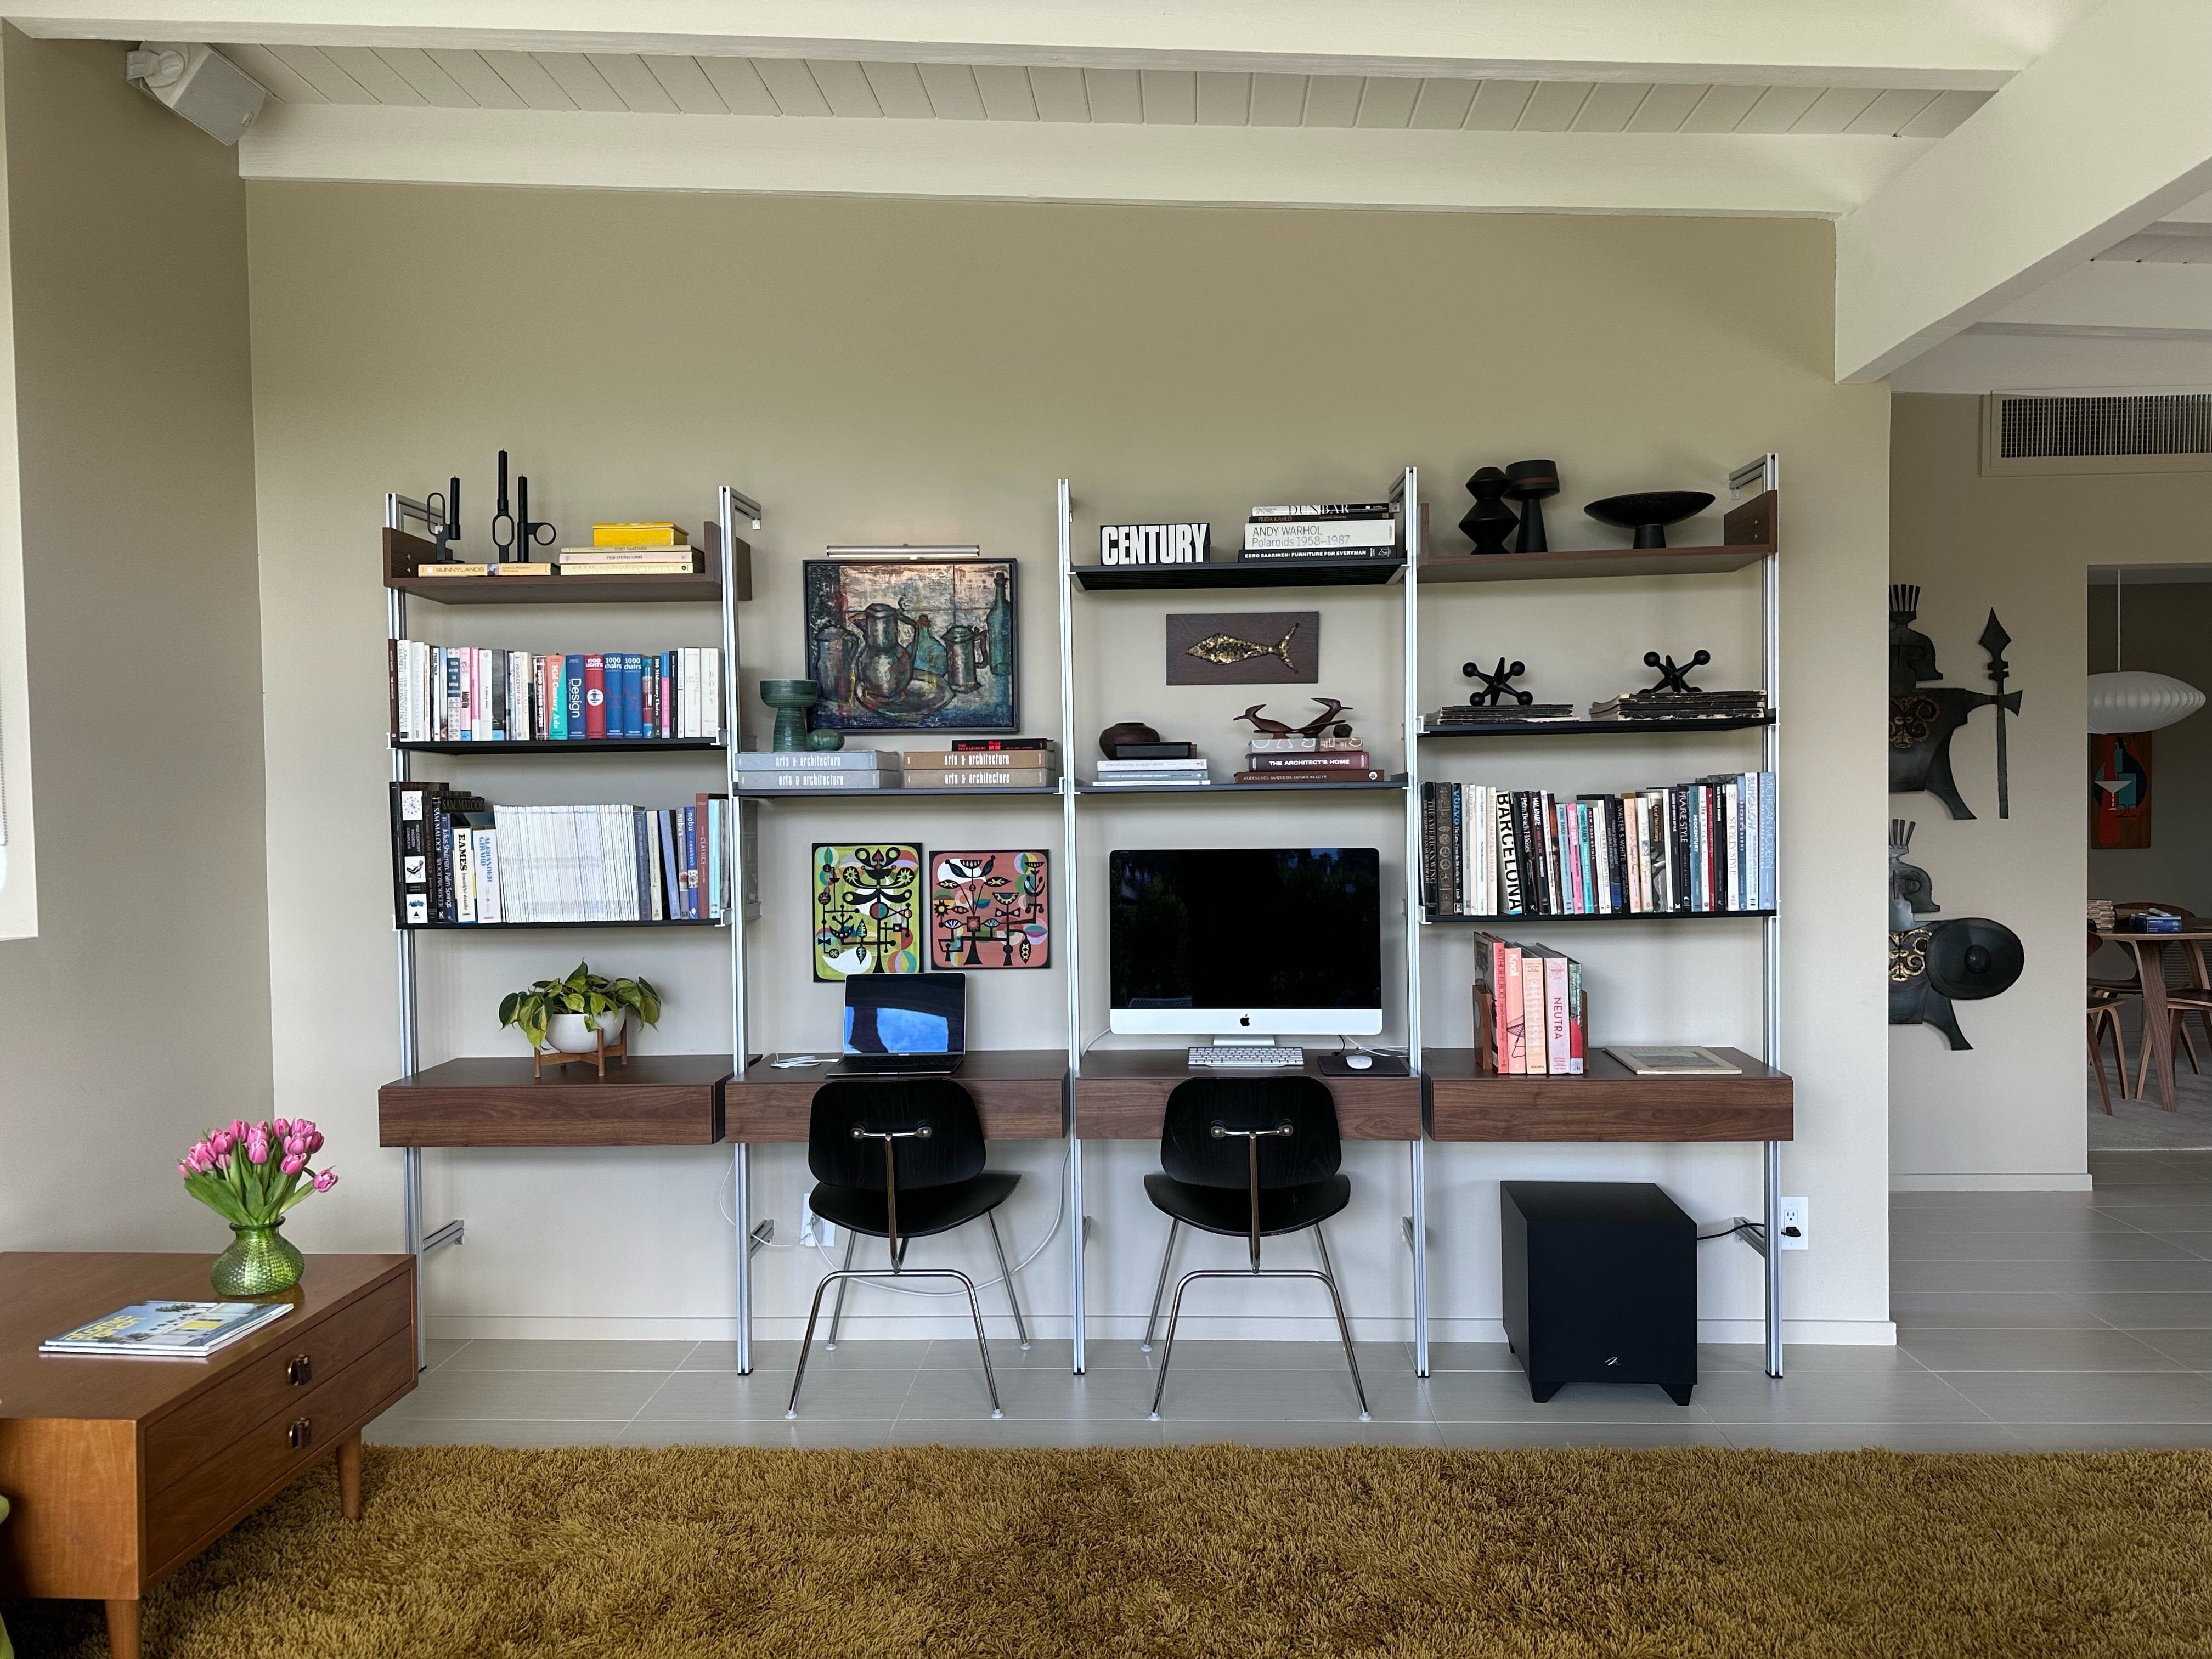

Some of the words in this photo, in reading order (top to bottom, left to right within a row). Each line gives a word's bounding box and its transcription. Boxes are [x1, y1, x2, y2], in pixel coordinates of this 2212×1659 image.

[1290, 505, 1349, 515] DUNBAR
[1253, 527, 1279, 536] ANDY
[1282, 526, 1322, 535] WARHOL
[1102, 524, 1207, 565] CENTURY
[1252, 537, 1294, 547] Polaroids
[569, 678, 582, 718] Design
[776, 756, 789, 766] arts
[800, 755, 840, 766] architecture
[945, 754, 957, 765] arts
[961, 755, 966, 765] &
[969, 753, 1009, 765] architecture
[779, 775, 792, 785] arts
[795, 775, 800, 785] &
[803, 774, 844, 785] architecture
[945, 773, 958, 784] arts
[962, 774, 966, 784] &
[969, 772, 1009, 784] architecture
[443, 800, 455, 810] SAM
[1533, 797, 1541, 826] MALAPARTE
[1571, 830, 1579, 845] ranch
[458, 834, 466, 871] EAMES
[1497, 793, 1522, 910] BARCELONA
[1509, 953, 1518, 977] Knoll
[1554, 997, 1562, 1039] NEUTRA
